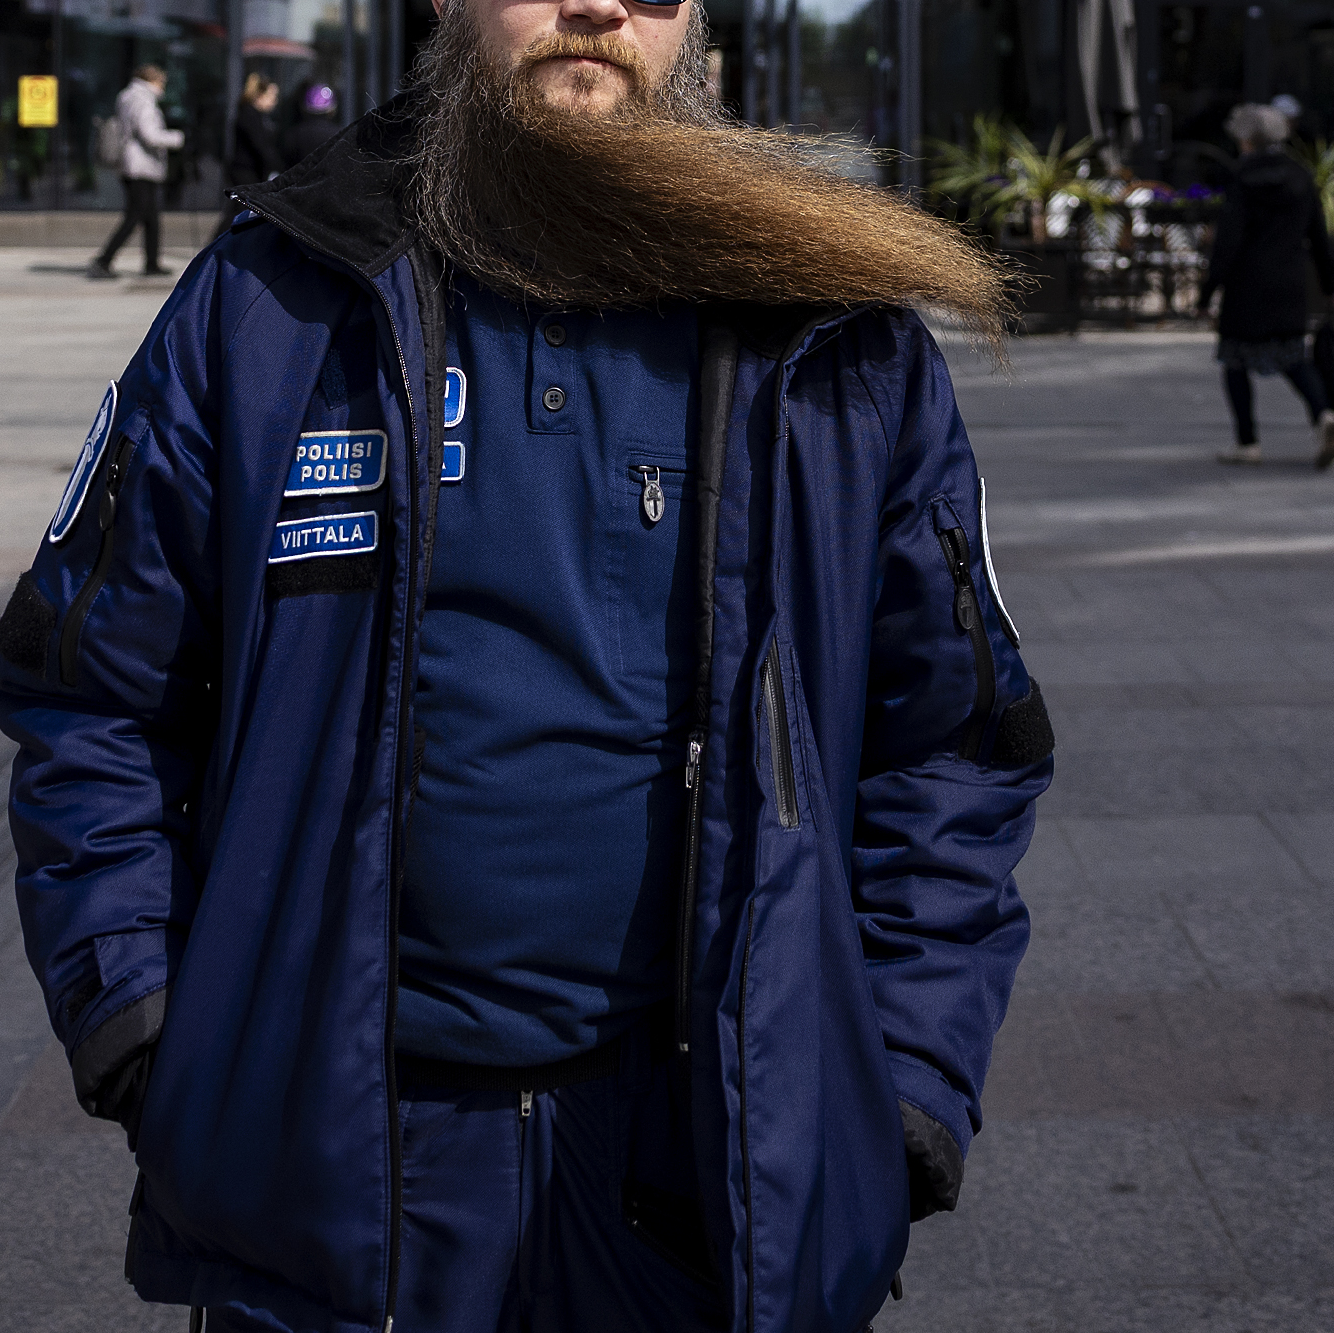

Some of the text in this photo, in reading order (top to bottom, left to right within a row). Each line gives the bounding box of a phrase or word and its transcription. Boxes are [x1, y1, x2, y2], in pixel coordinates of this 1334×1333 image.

[296, 442, 371, 461] POLIISI
[301, 464, 362, 481] POLIS
[281, 524, 364, 549] VIITTALA
